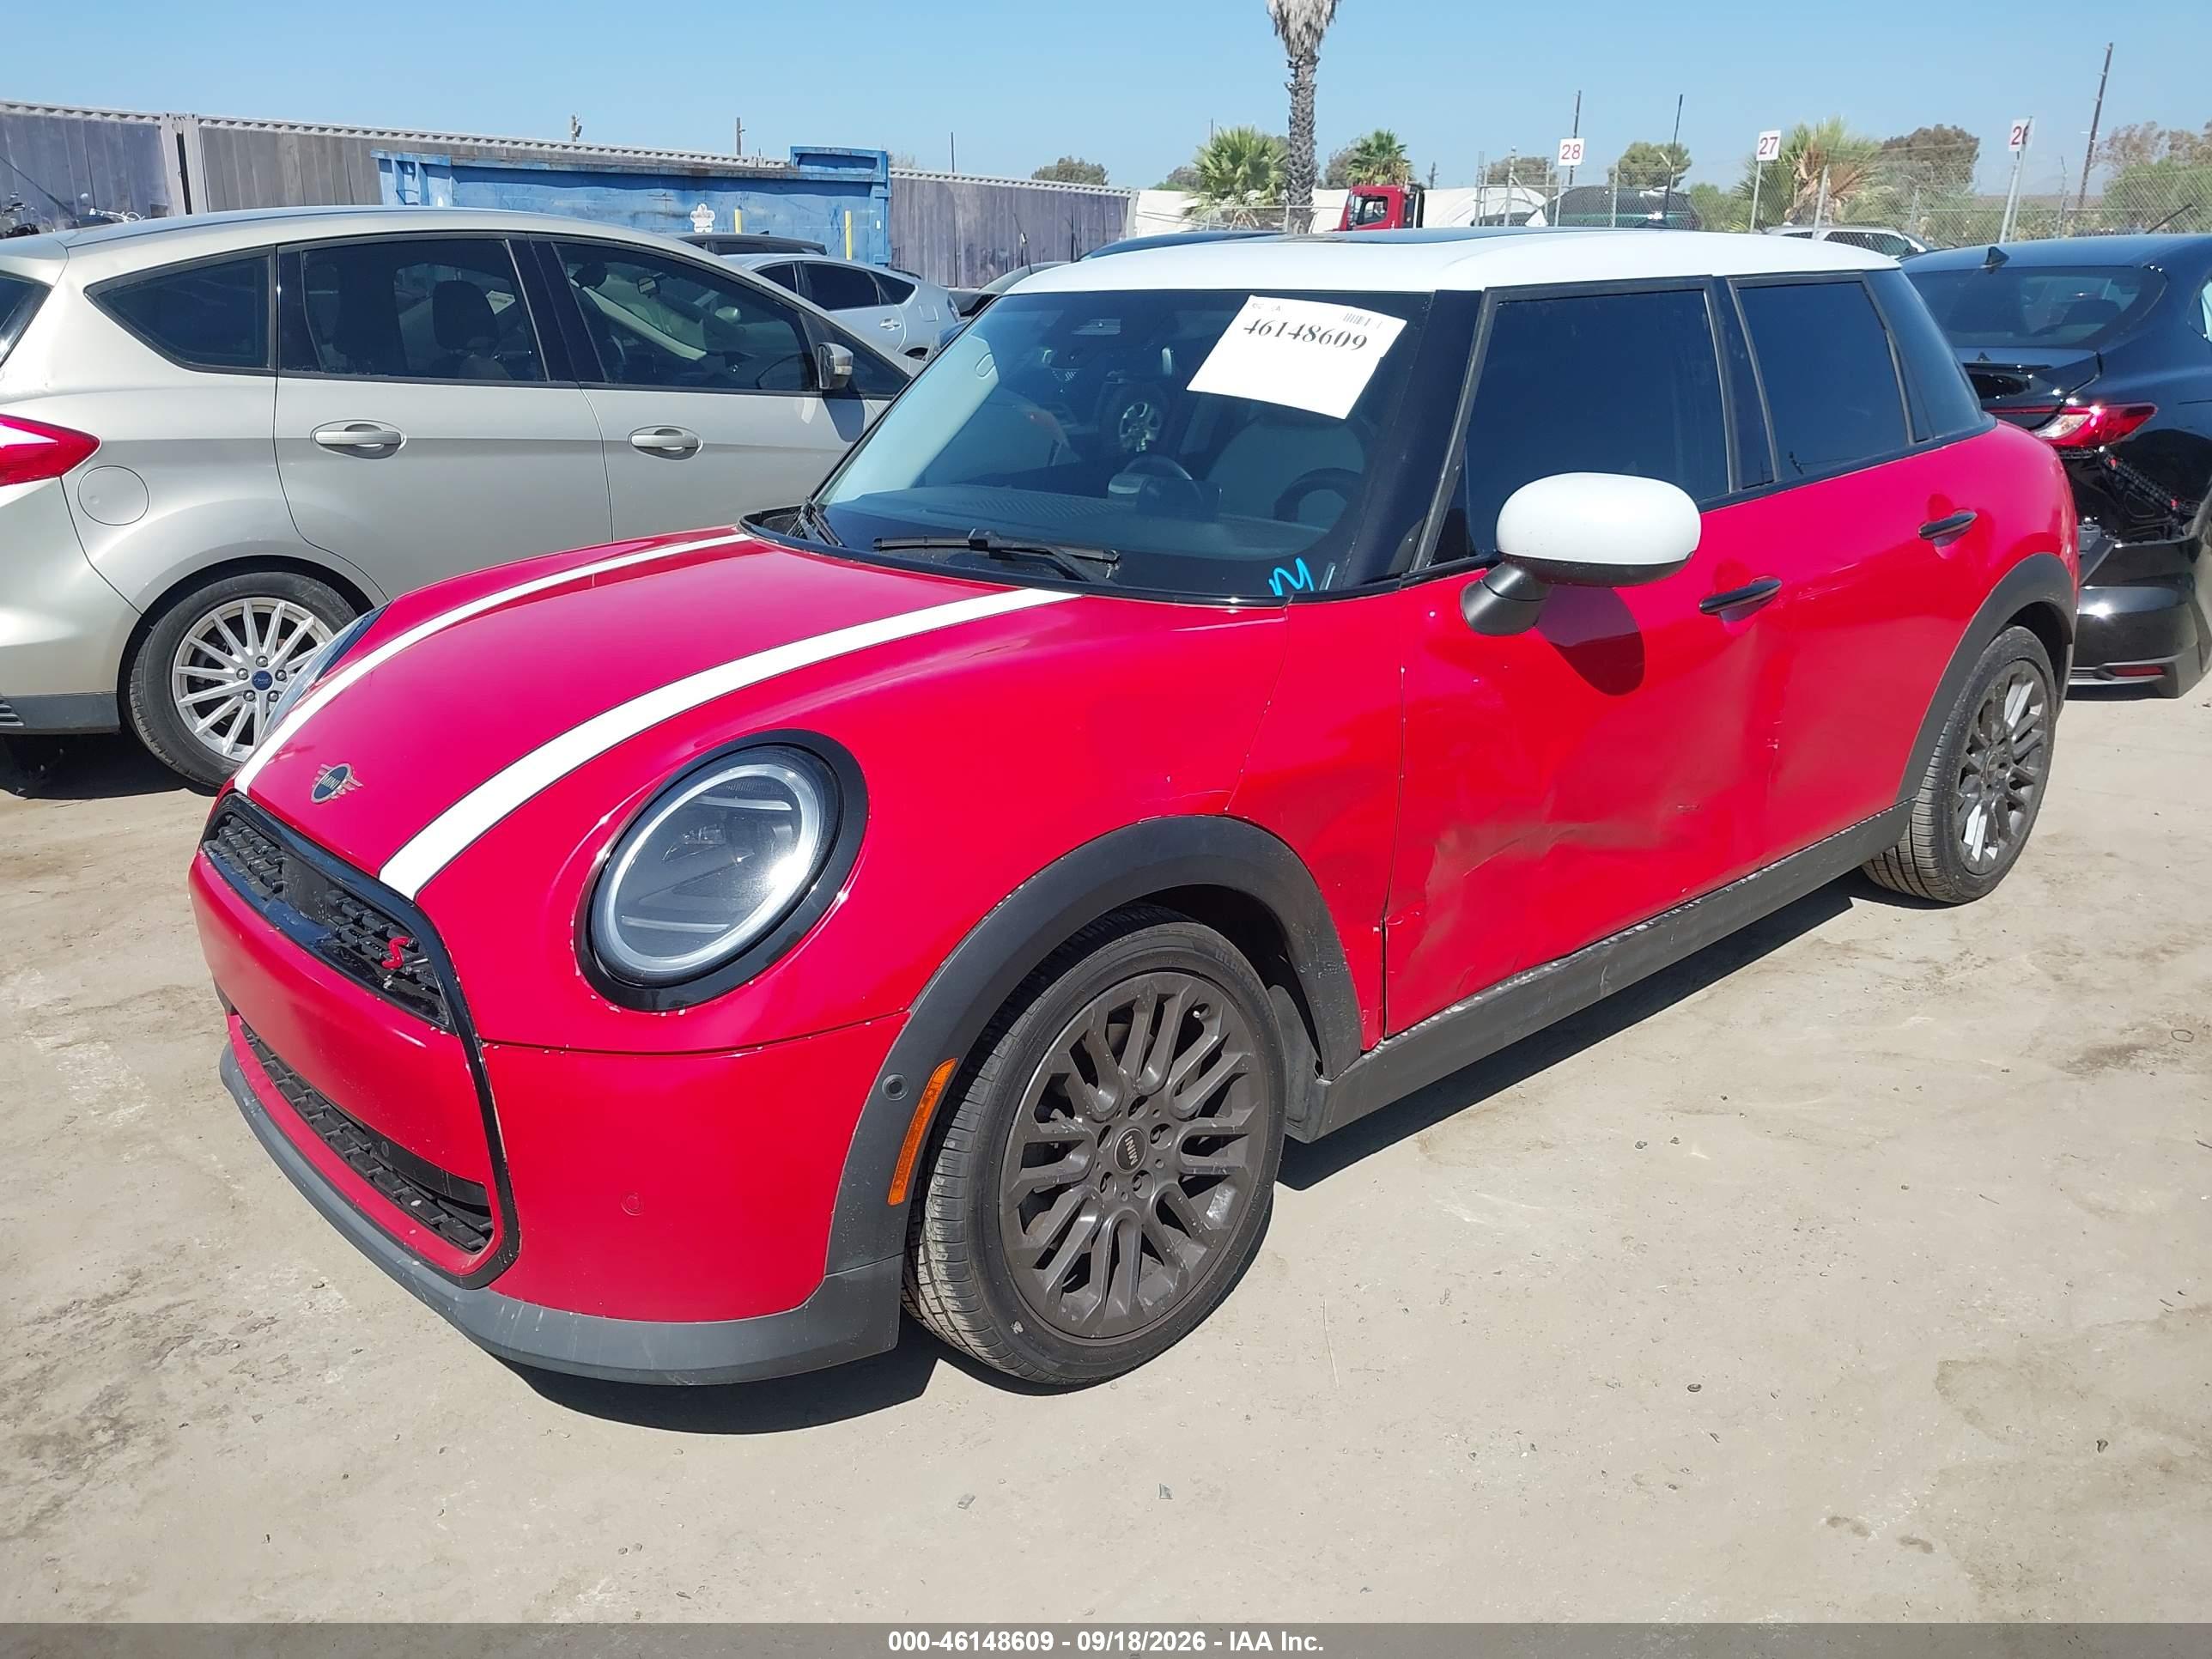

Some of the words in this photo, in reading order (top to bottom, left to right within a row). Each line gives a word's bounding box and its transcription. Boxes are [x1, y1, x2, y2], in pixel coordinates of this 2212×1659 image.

[1561, 143, 1581, 159] 28
[1759, 137, 1778, 155] 27
[1243, 318, 1368, 351] 46148609
[320, 775, 341, 790] MINI
[382, 936, 410, 969] S
[1124, 1135, 1139, 1166] MINI
